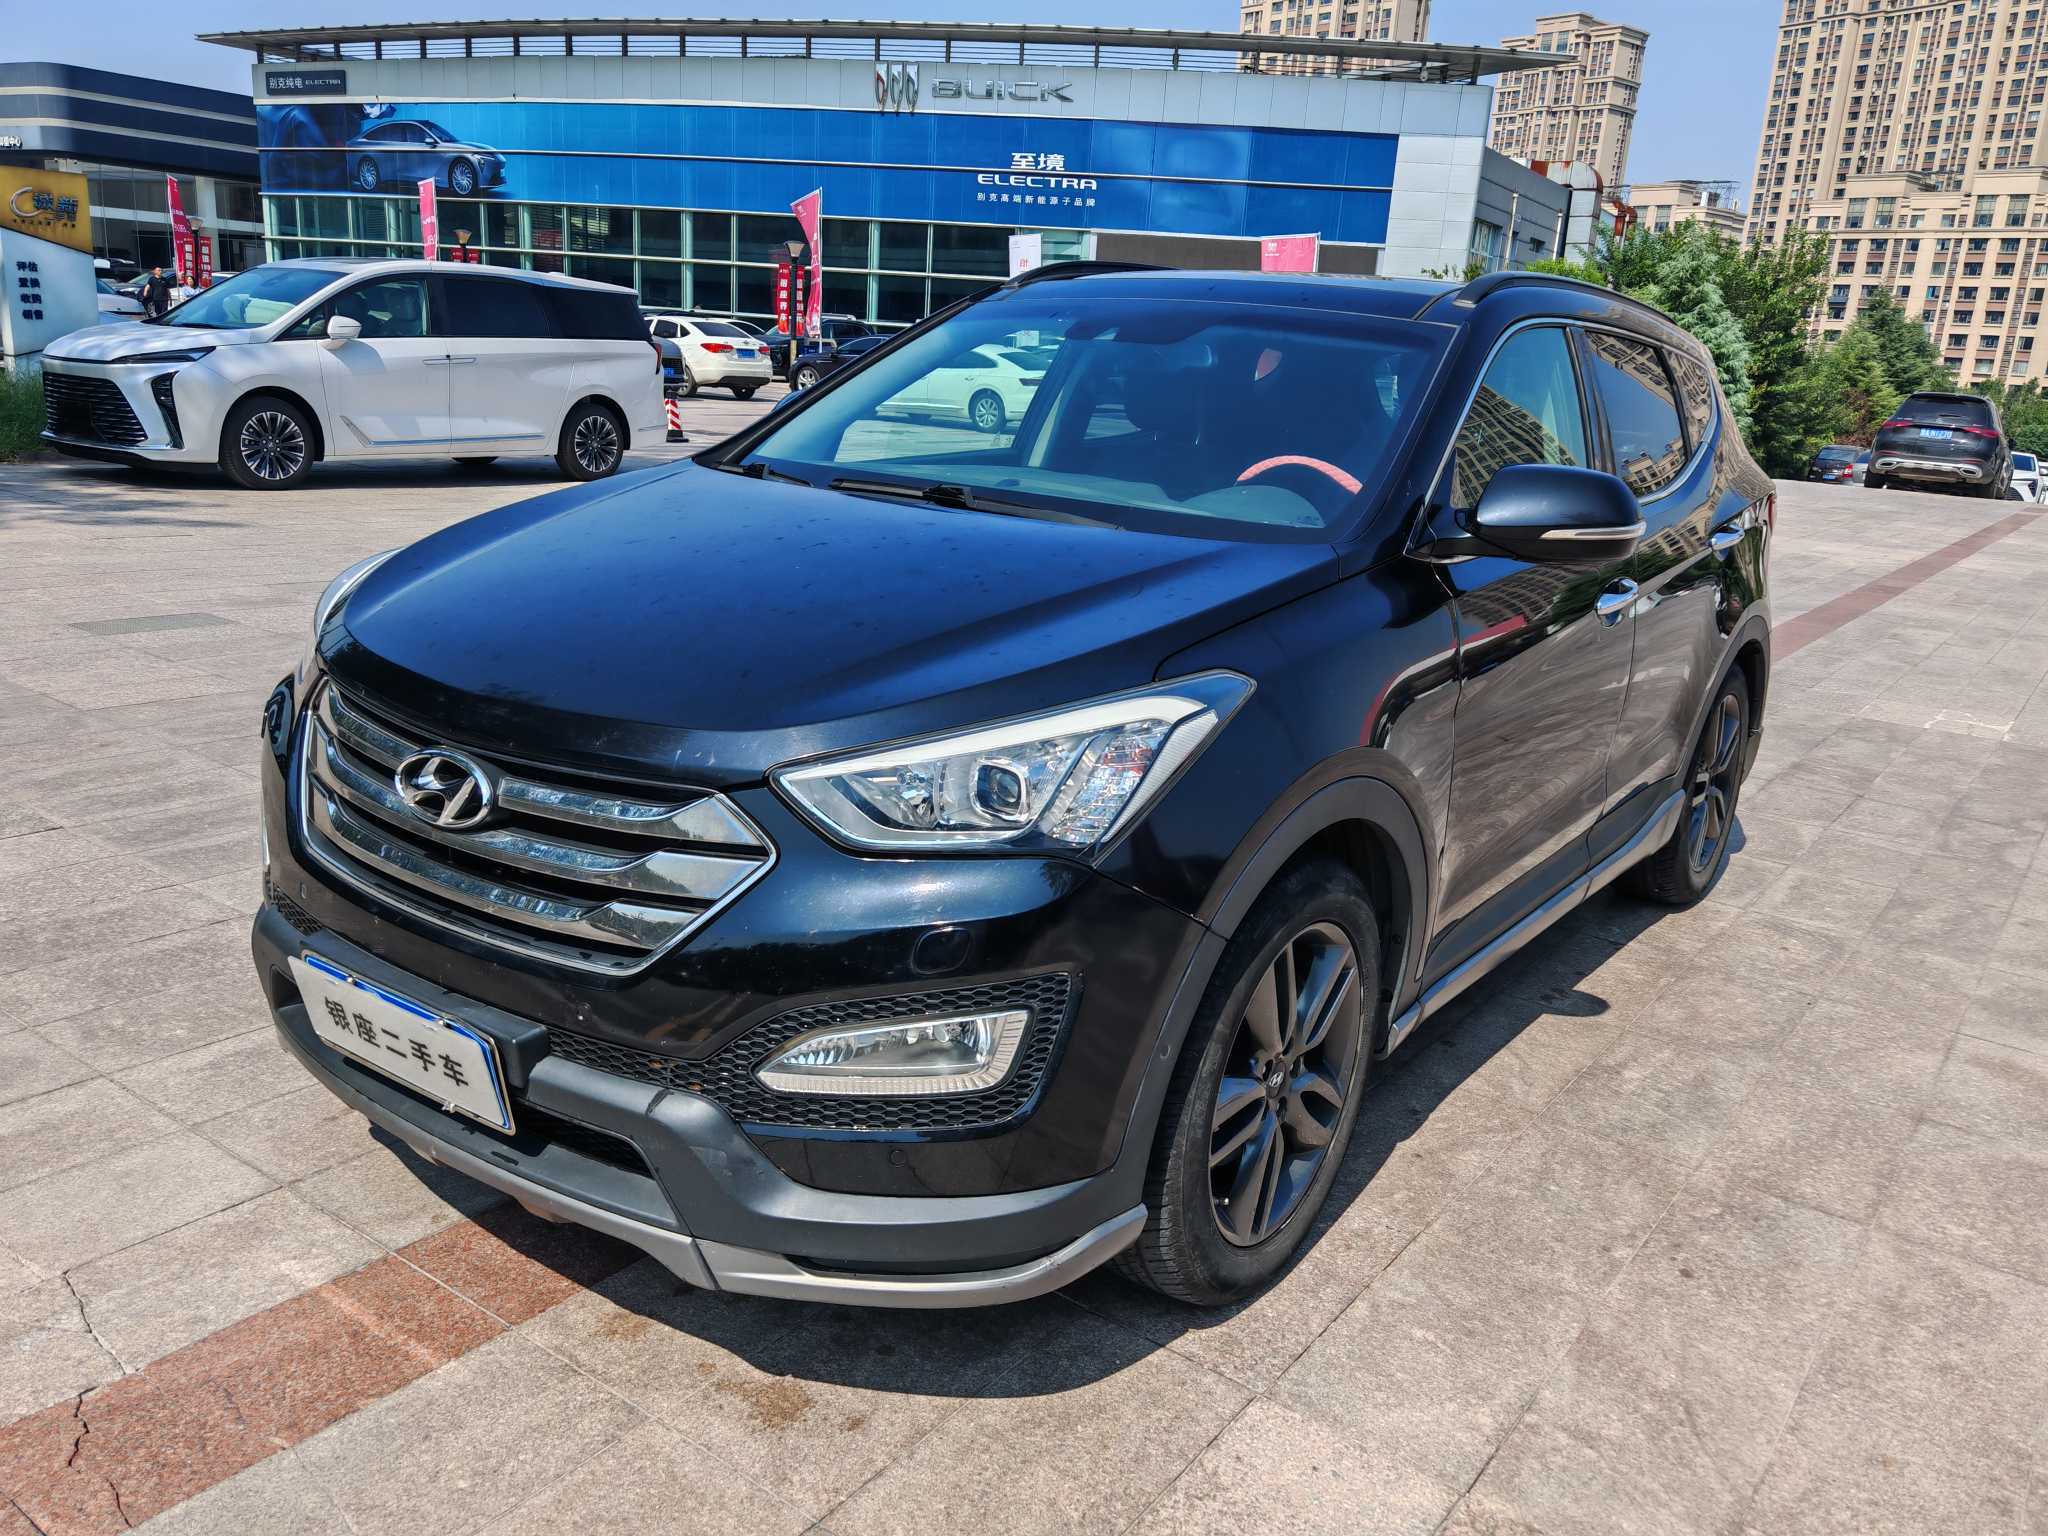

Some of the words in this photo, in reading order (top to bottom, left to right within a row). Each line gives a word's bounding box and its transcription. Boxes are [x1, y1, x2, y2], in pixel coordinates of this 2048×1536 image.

[269, 77, 304, 89] 别克纯电
[931, 78, 1075, 103] BUICK
[1010, 152, 1065, 171] 至境
[977, 173, 1098, 190] ELECTRA
[976, 192, 1096, 207] 别克高端新能源子品牌
[324, 996, 470, 1087] 银座二手车
